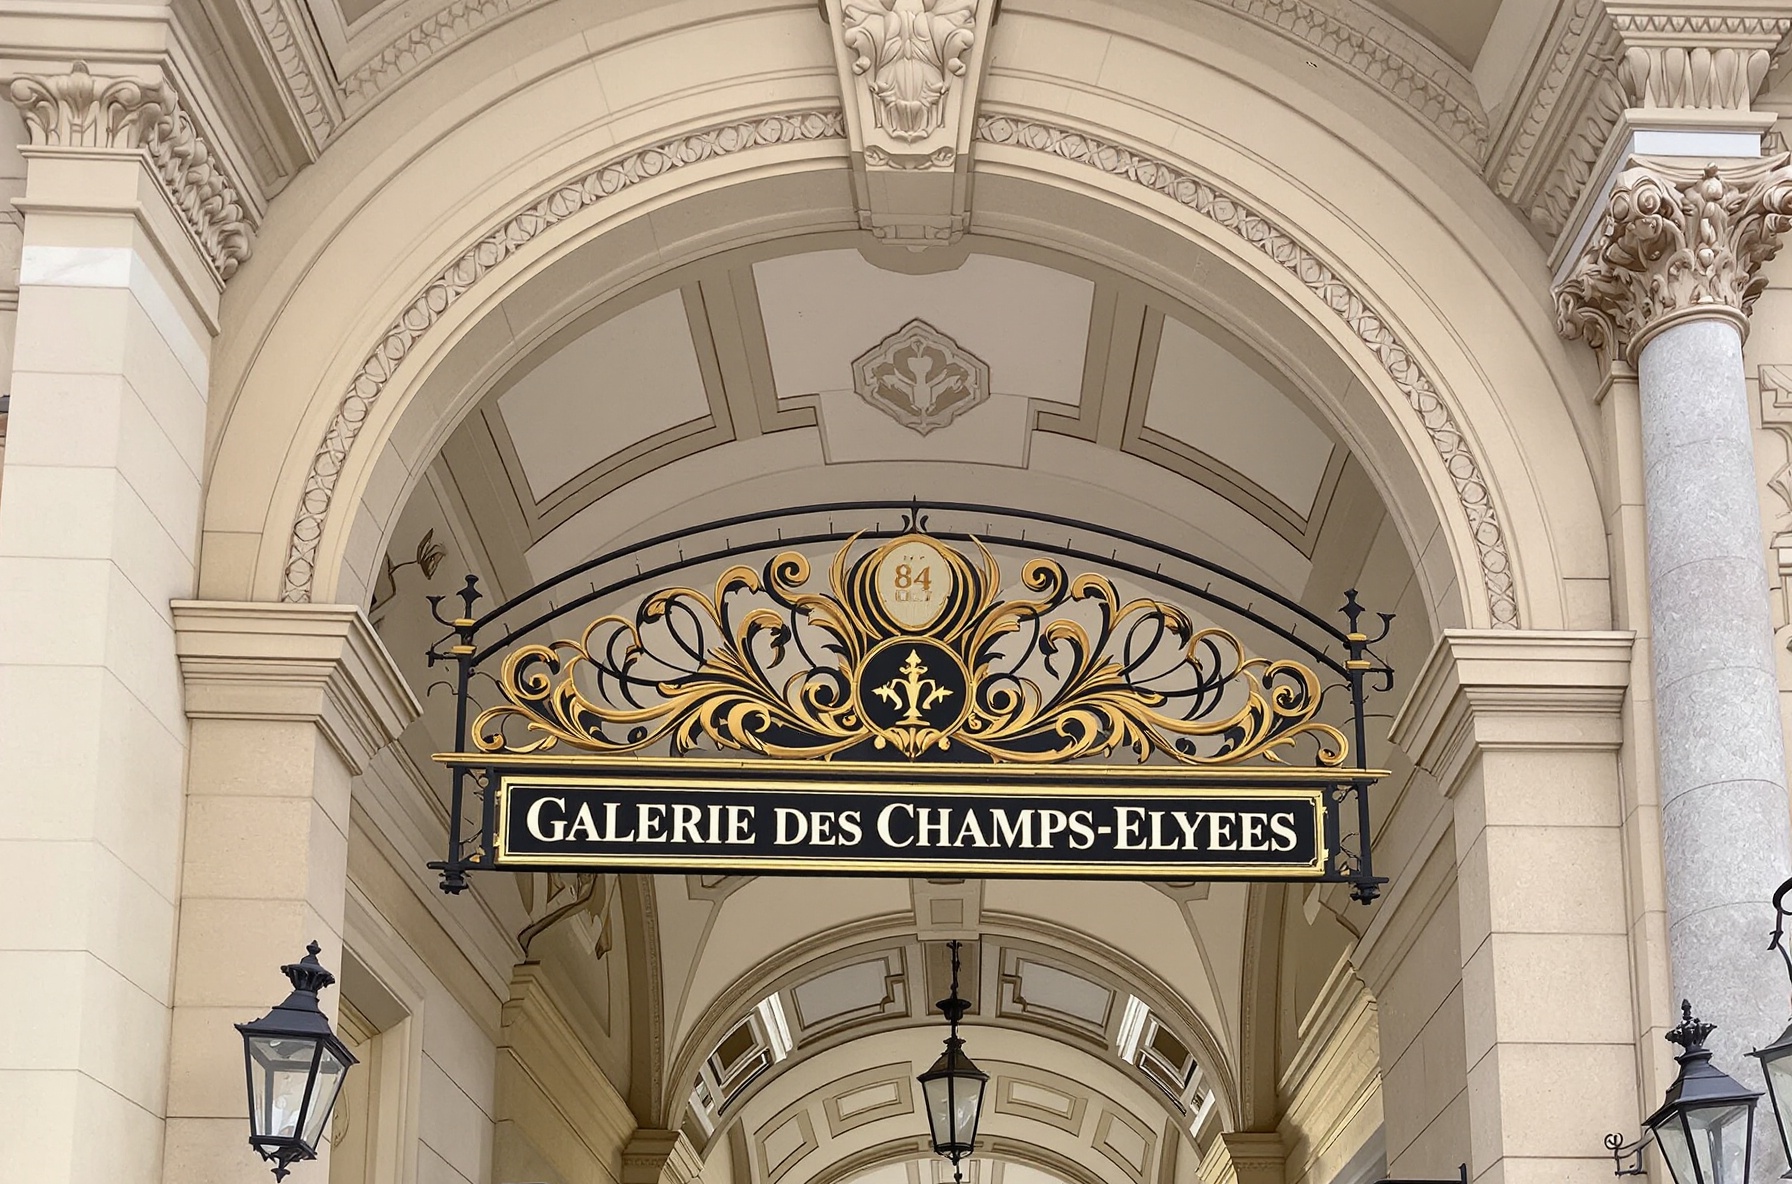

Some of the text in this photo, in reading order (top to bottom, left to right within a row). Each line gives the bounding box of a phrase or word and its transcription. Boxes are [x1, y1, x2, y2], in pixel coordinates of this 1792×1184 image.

[894, 563, 932, 591] 84
[526, 796, 1298, 853] GALERIE DES CHAMPS-ELYEES
